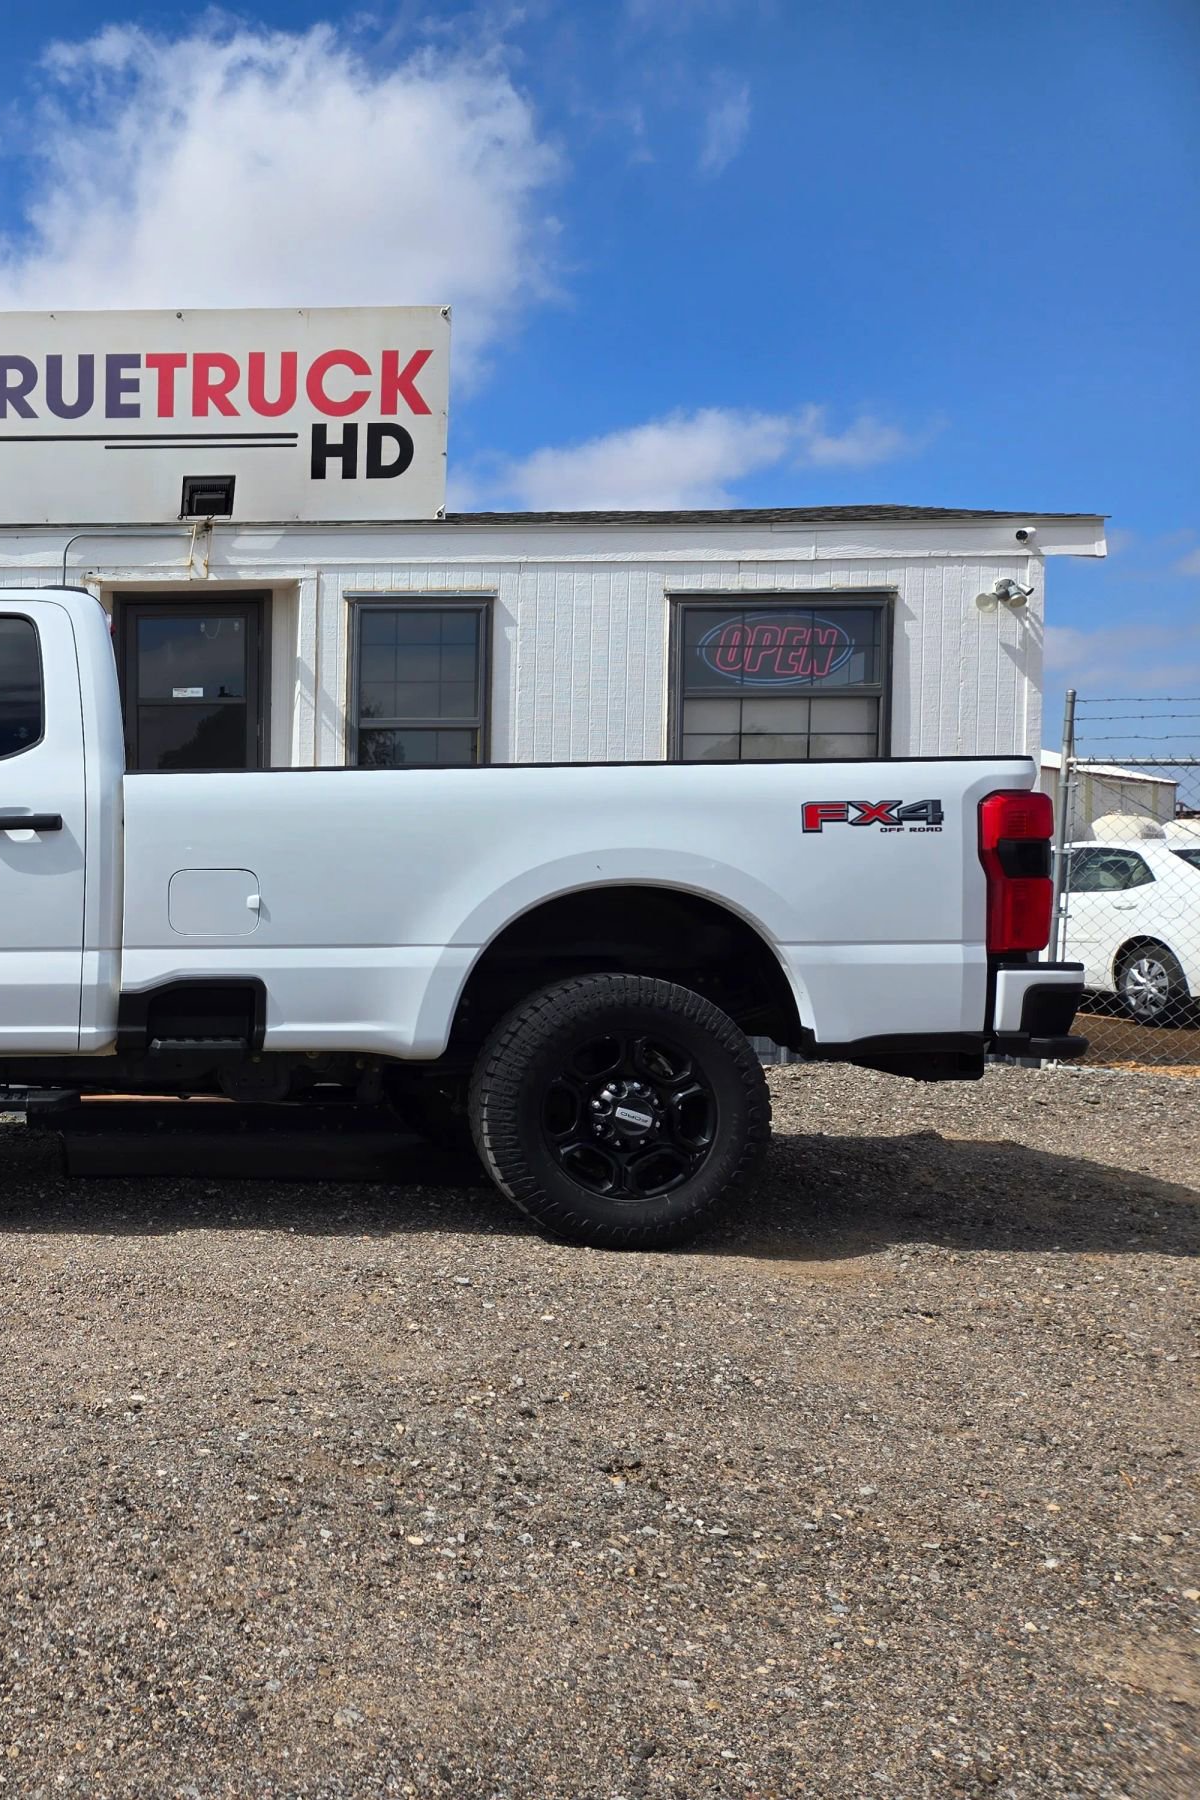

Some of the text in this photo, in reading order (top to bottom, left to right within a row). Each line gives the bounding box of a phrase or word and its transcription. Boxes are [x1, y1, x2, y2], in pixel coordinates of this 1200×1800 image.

[311, 422, 415, 480] HD
[715, 624, 838, 676] OPEN
[801, 799, 945, 834] FX4
